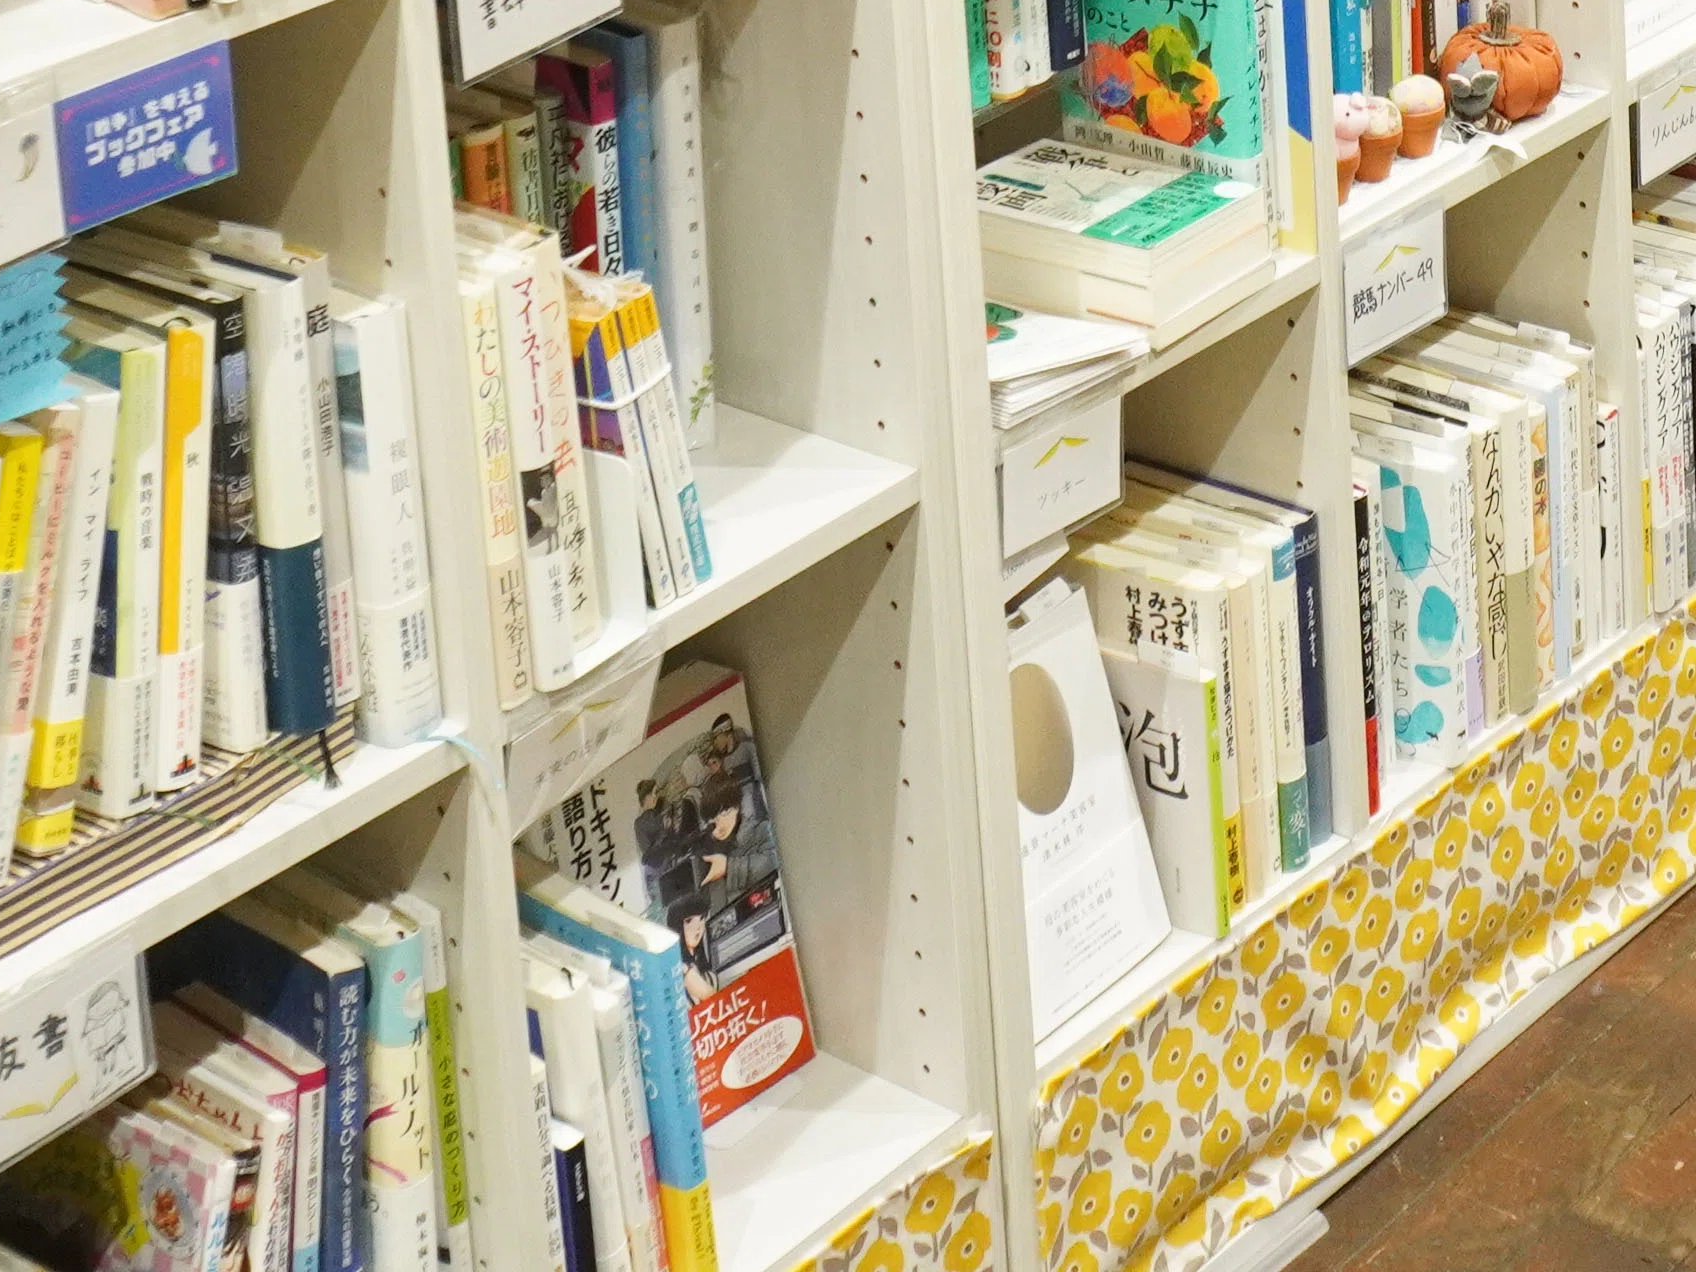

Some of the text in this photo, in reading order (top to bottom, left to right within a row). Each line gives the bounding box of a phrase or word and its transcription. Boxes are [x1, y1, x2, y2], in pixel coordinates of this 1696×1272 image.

[1086, 6, 1131, 33] のこと
[83, 107, 207, 167] ブックフェア
[116, 138, 182, 179] 参加中
[305, 301, 332, 338] 庭
[1415, 255, 1436, 285] 49
[470, 299, 519, 540] わたしの美術遊園地
[1357, 535, 1377, 704] 令和元年のテロリズム
[1116, 700, 1190, 802] 泡
[561, 790, 592, 880] 語り方
[589, 779, 626, 914] ドキュメン
[336, 982, 359, 1180] 読む力が未来をひらく
[399, 1020, 432, 1172] オール・ノット
[436, 1057, 468, 1220] 小さな庭のつくり方
